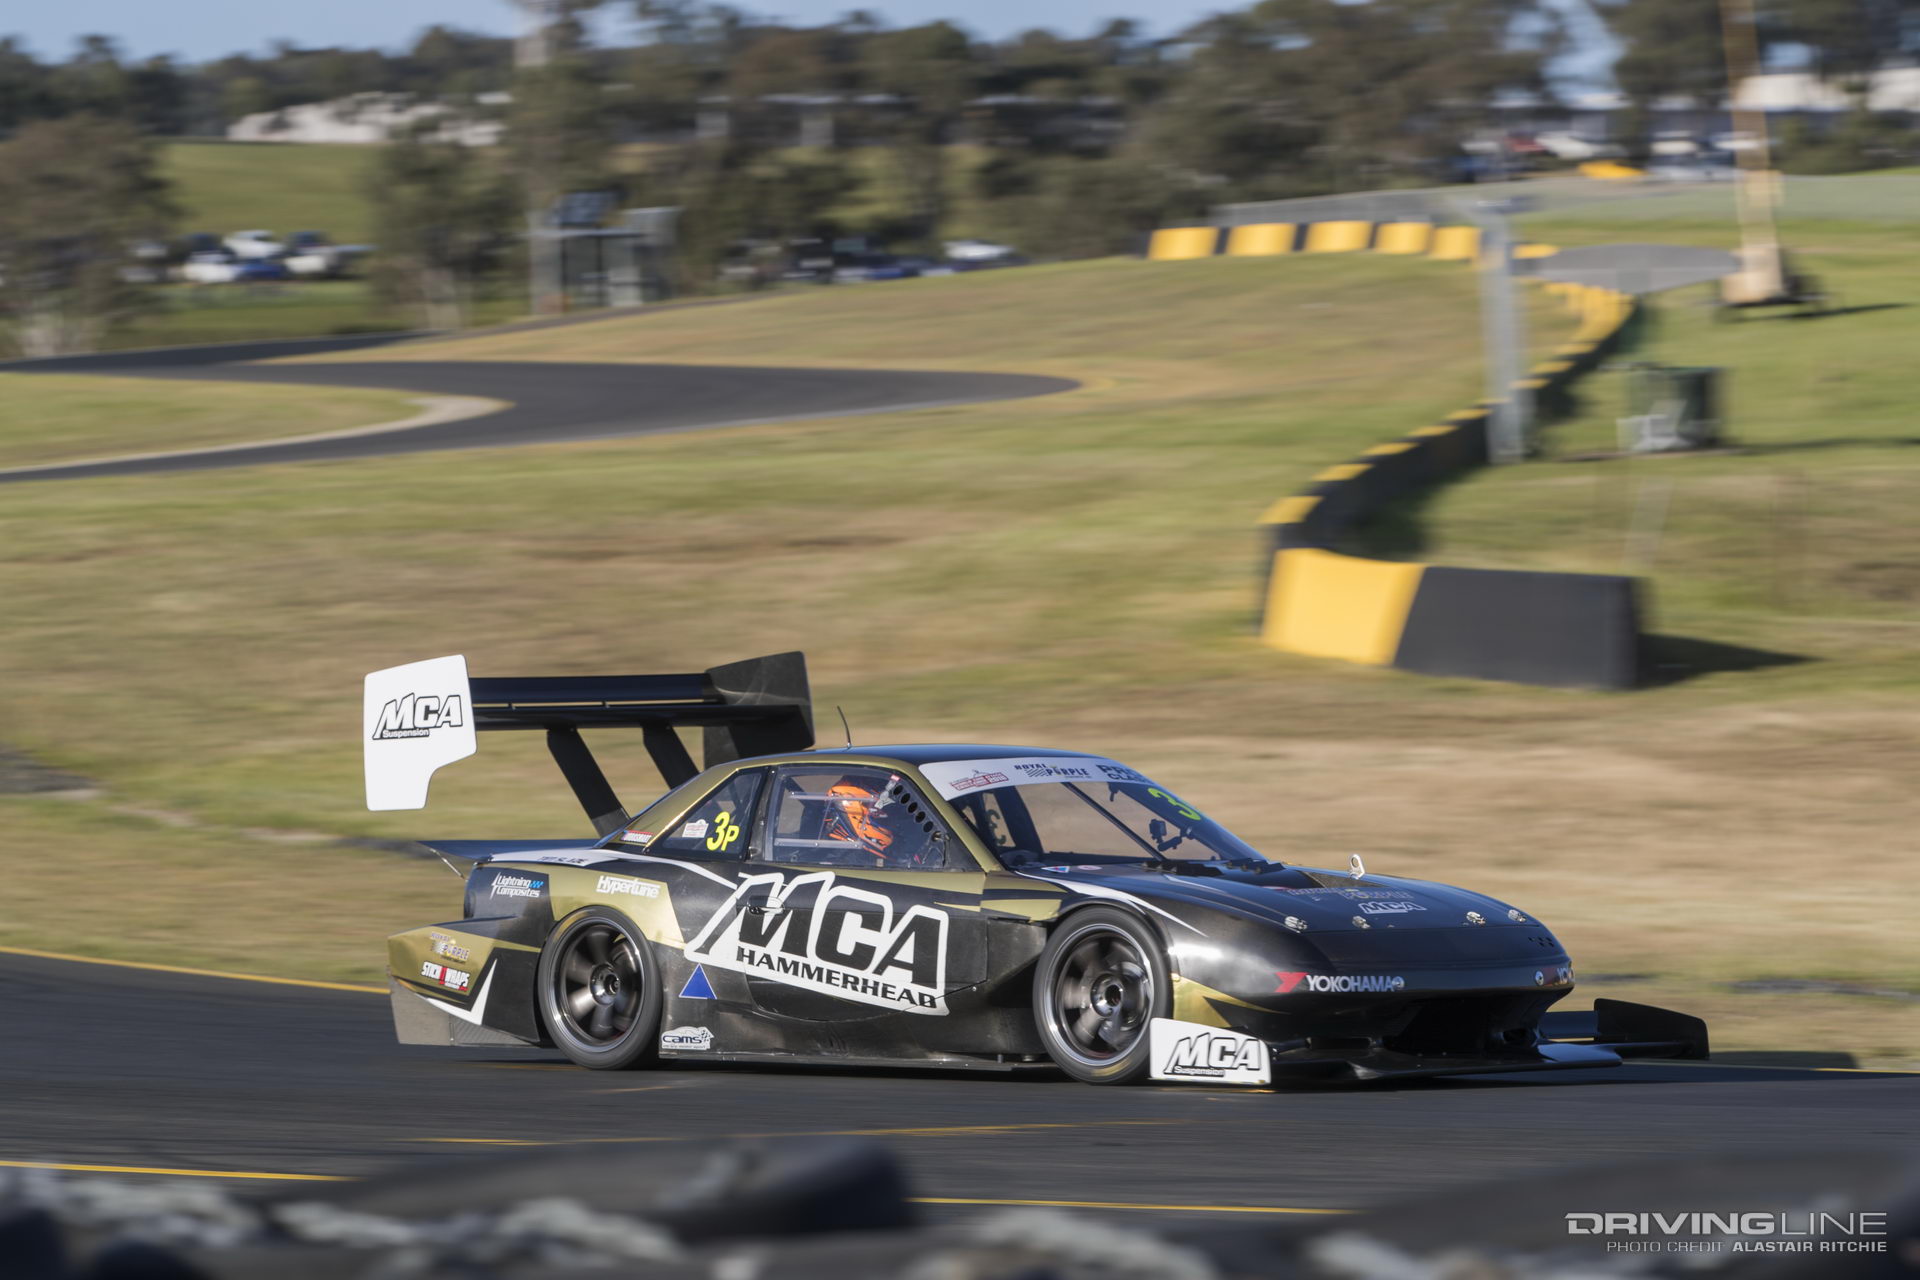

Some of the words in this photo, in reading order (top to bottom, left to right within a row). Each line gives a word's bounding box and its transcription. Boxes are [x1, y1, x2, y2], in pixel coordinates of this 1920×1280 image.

[372, 692, 463, 740] MCA
[1014, 763, 1047, 771] ROYAL
[1047, 767, 1089, 776] PURPLE
[706, 811, 740, 852] 3P
[498, 874, 532, 889] Lightning
[596, 875, 661, 898] Hypertune
[496, 886, 541, 898] Composites
[1358, 901, 1427, 914] MCA
[684, 871, 949, 991] MCA
[737, 945, 938, 1009] HAMMERHEAD
[1306, 974, 1394, 992] YOKOHAMA
[662, 1035, 703, 1044] cams
[1163, 1032, 1261, 1075] MCA
